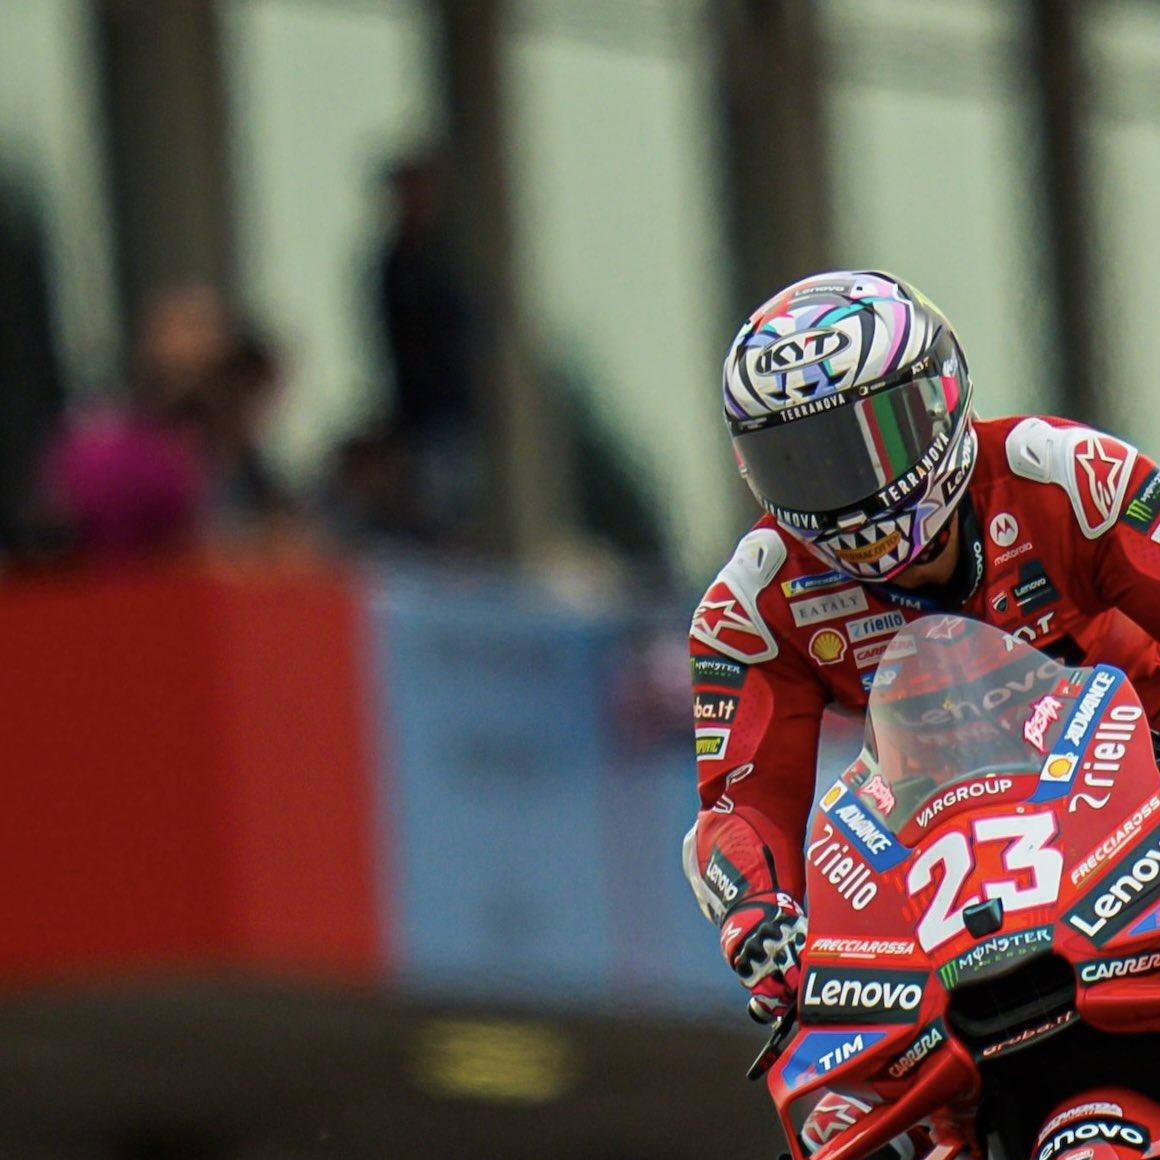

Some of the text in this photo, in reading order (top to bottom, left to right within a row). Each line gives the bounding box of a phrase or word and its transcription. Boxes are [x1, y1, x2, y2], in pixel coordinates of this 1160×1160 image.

[761, 333, 838, 373] KYT
[780, 393, 846, 422] TERRANOVA
[878, 432, 950, 508] TERRANOVA
[993, 542, 1033, 567] motorola
[798, 594, 858, 619] EATALY
[1013, 577, 1047, 598] Lenovo
[863, 613, 903, 635] riello
[1063, 671, 1116, 748] ADVANCE
[1083, 705, 1143, 787] riello
[813, 842, 878, 912] riello
[906, 811, 1064, 953] 23
[810, 938, 915, 955] FRECCIAROSSA
[958, 929, 1052, 970] MONSTER
[804, 972, 923, 1011] Lenovo
[818, 1034, 865, 1071] TIM
[888, 1027, 944, 1079] CARRERA
